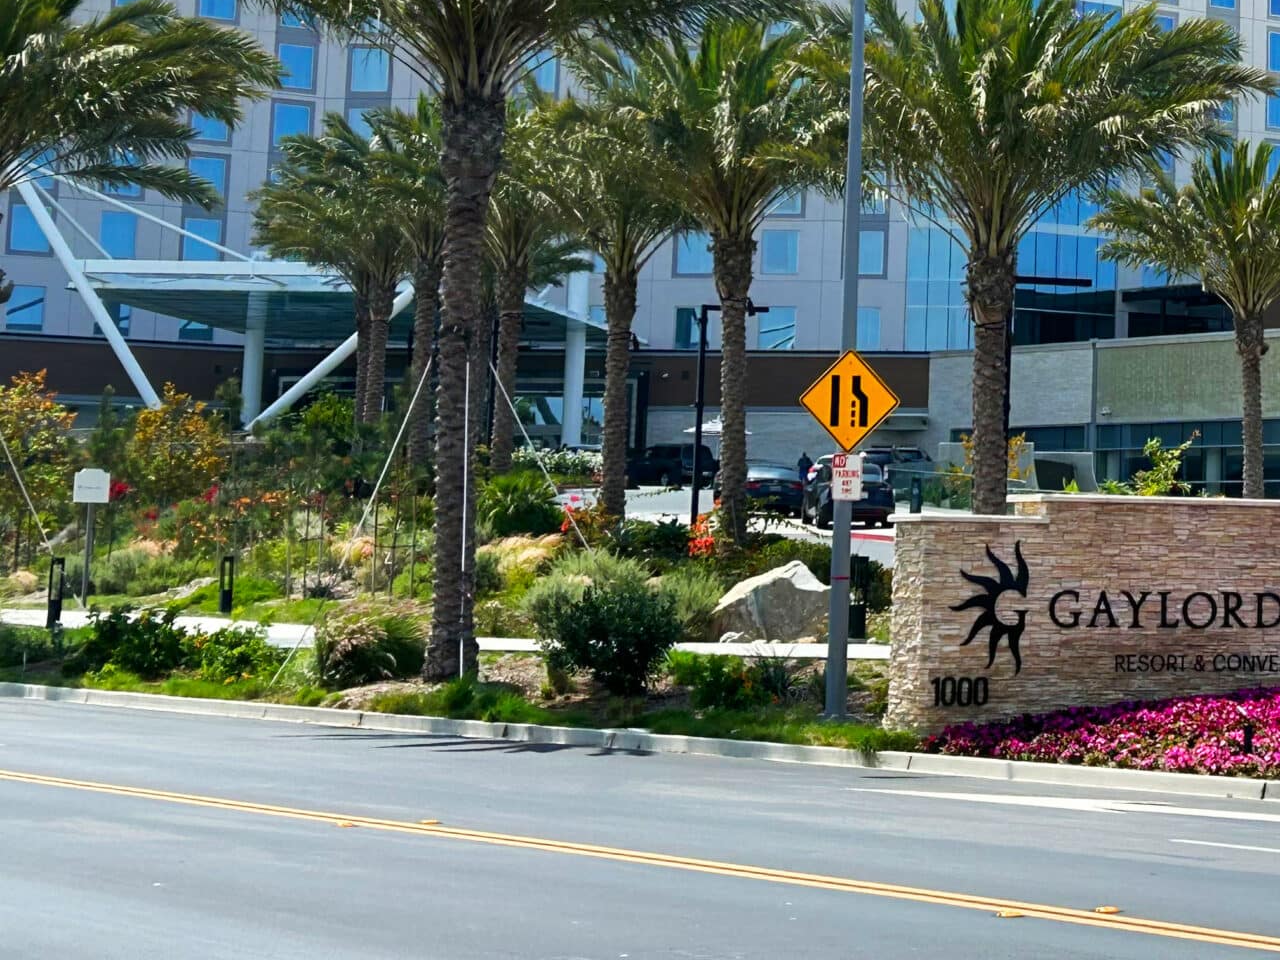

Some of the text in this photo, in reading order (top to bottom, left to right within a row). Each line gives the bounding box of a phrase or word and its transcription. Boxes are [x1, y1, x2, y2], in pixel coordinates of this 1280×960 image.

[834, 455, 846, 467] NO
[1115, 654, 1186, 672] RESORT
[1193, 654, 1206, 672] &
[930, 676, 990, 707] 1000
